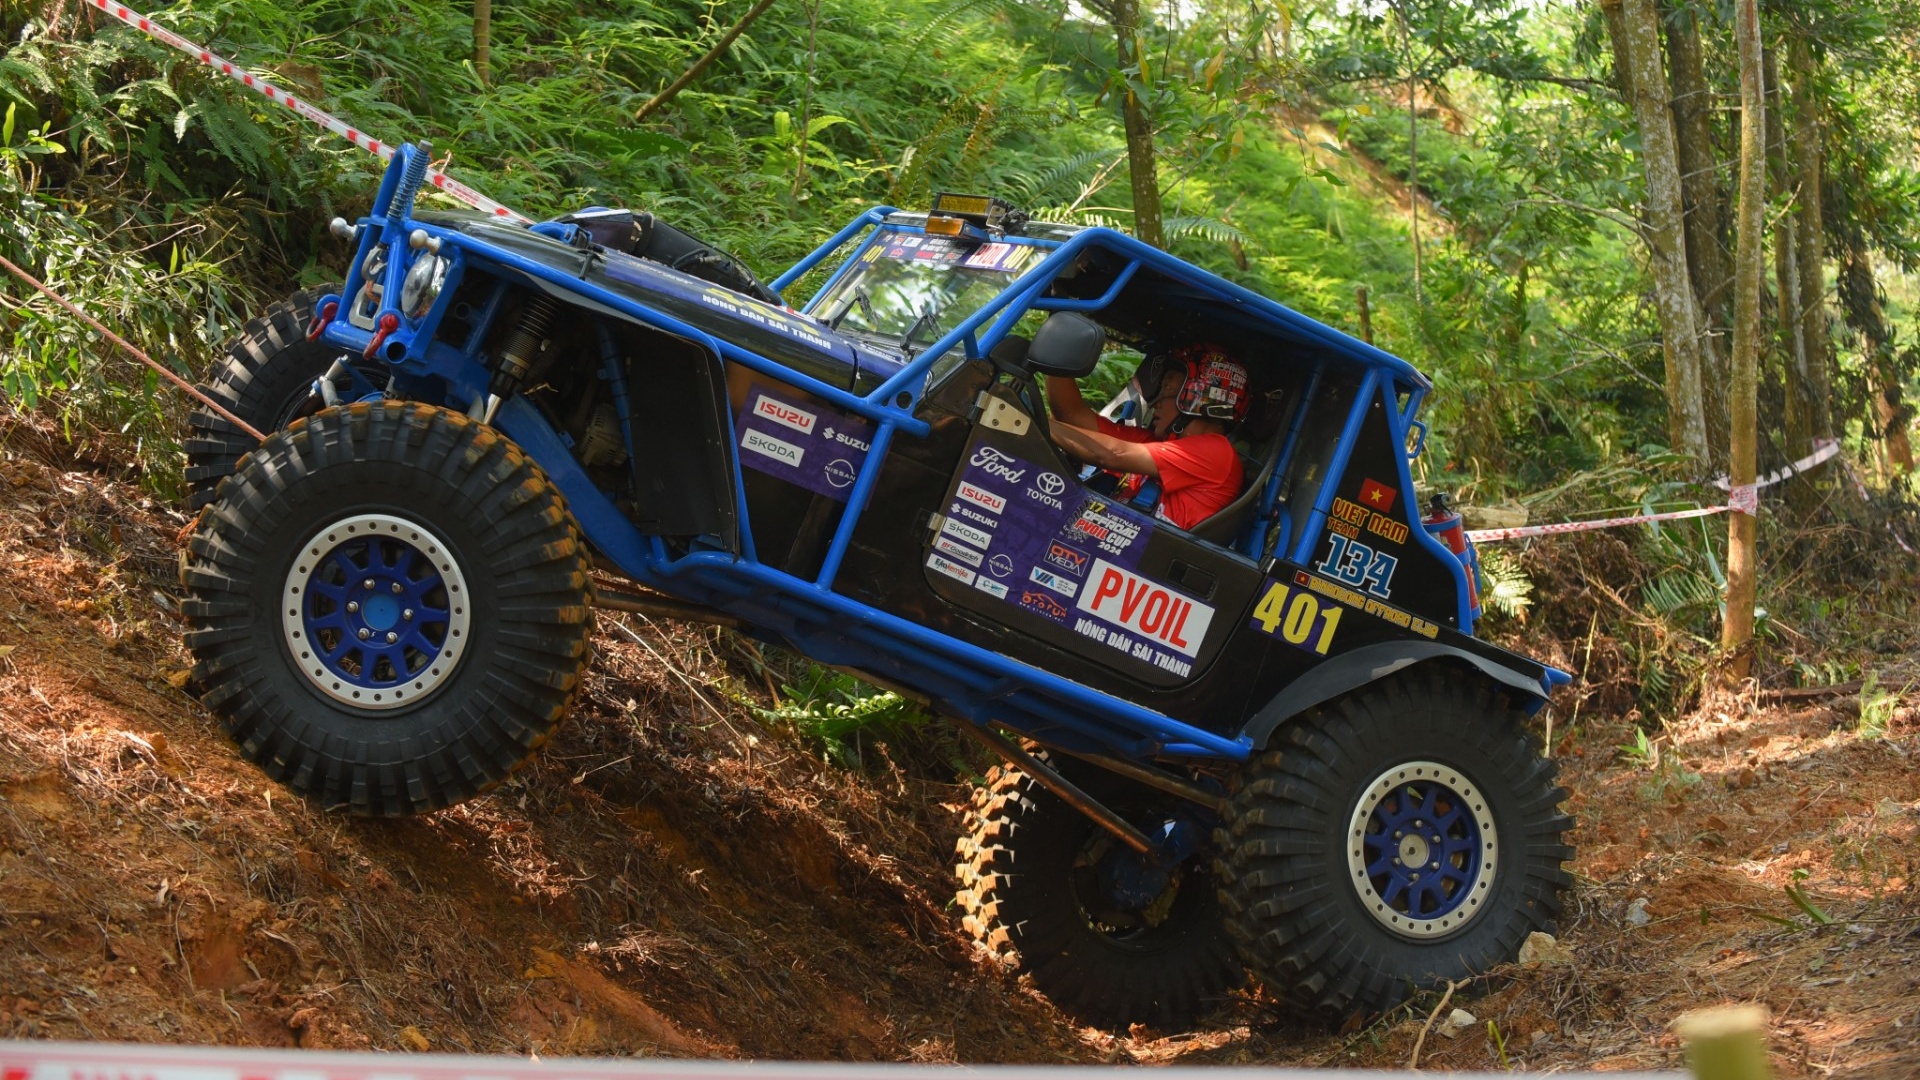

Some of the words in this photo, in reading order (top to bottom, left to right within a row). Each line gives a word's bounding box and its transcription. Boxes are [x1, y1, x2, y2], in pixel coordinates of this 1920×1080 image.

[760, 401, 811, 428] ISUZU
[824, 465, 856, 482] NISSAN
[970, 446, 1026, 483] Ford
[962, 486, 1002, 509] ISUZU
[1027, 487, 1063, 511] TOYOTA
[1089, 501, 1106, 513] 17
[961, 507, 998, 529] SUZUKI
[1082, 510, 1139, 540] OFFROAD
[1107, 512, 1141, 532] VIETNAM
[1326, 516, 1360, 540] TEAM
[1332, 497, 1370, 527] VIET
[1367, 512, 1409, 545] NAM
[1074, 517, 1109, 541] PVOIL
[1106, 532, 1132, 549] CUP
[1098, 541, 1122, 556] 2024
[989, 559, 1014, 573] NISSAN
[1048, 553, 1081, 577] MEDIA
[1318, 532, 1399, 600] 134
[1090, 567, 1192, 649] PVOIL
[1252, 581, 1344, 656] 401
[1364, 598, 1412, 628] OFFROAD
[1410, 616, 1440, 640] CLUB
[1074, 617, 1107, 642] NÔNG
[1107, 631, 1132, 653] DÂN
